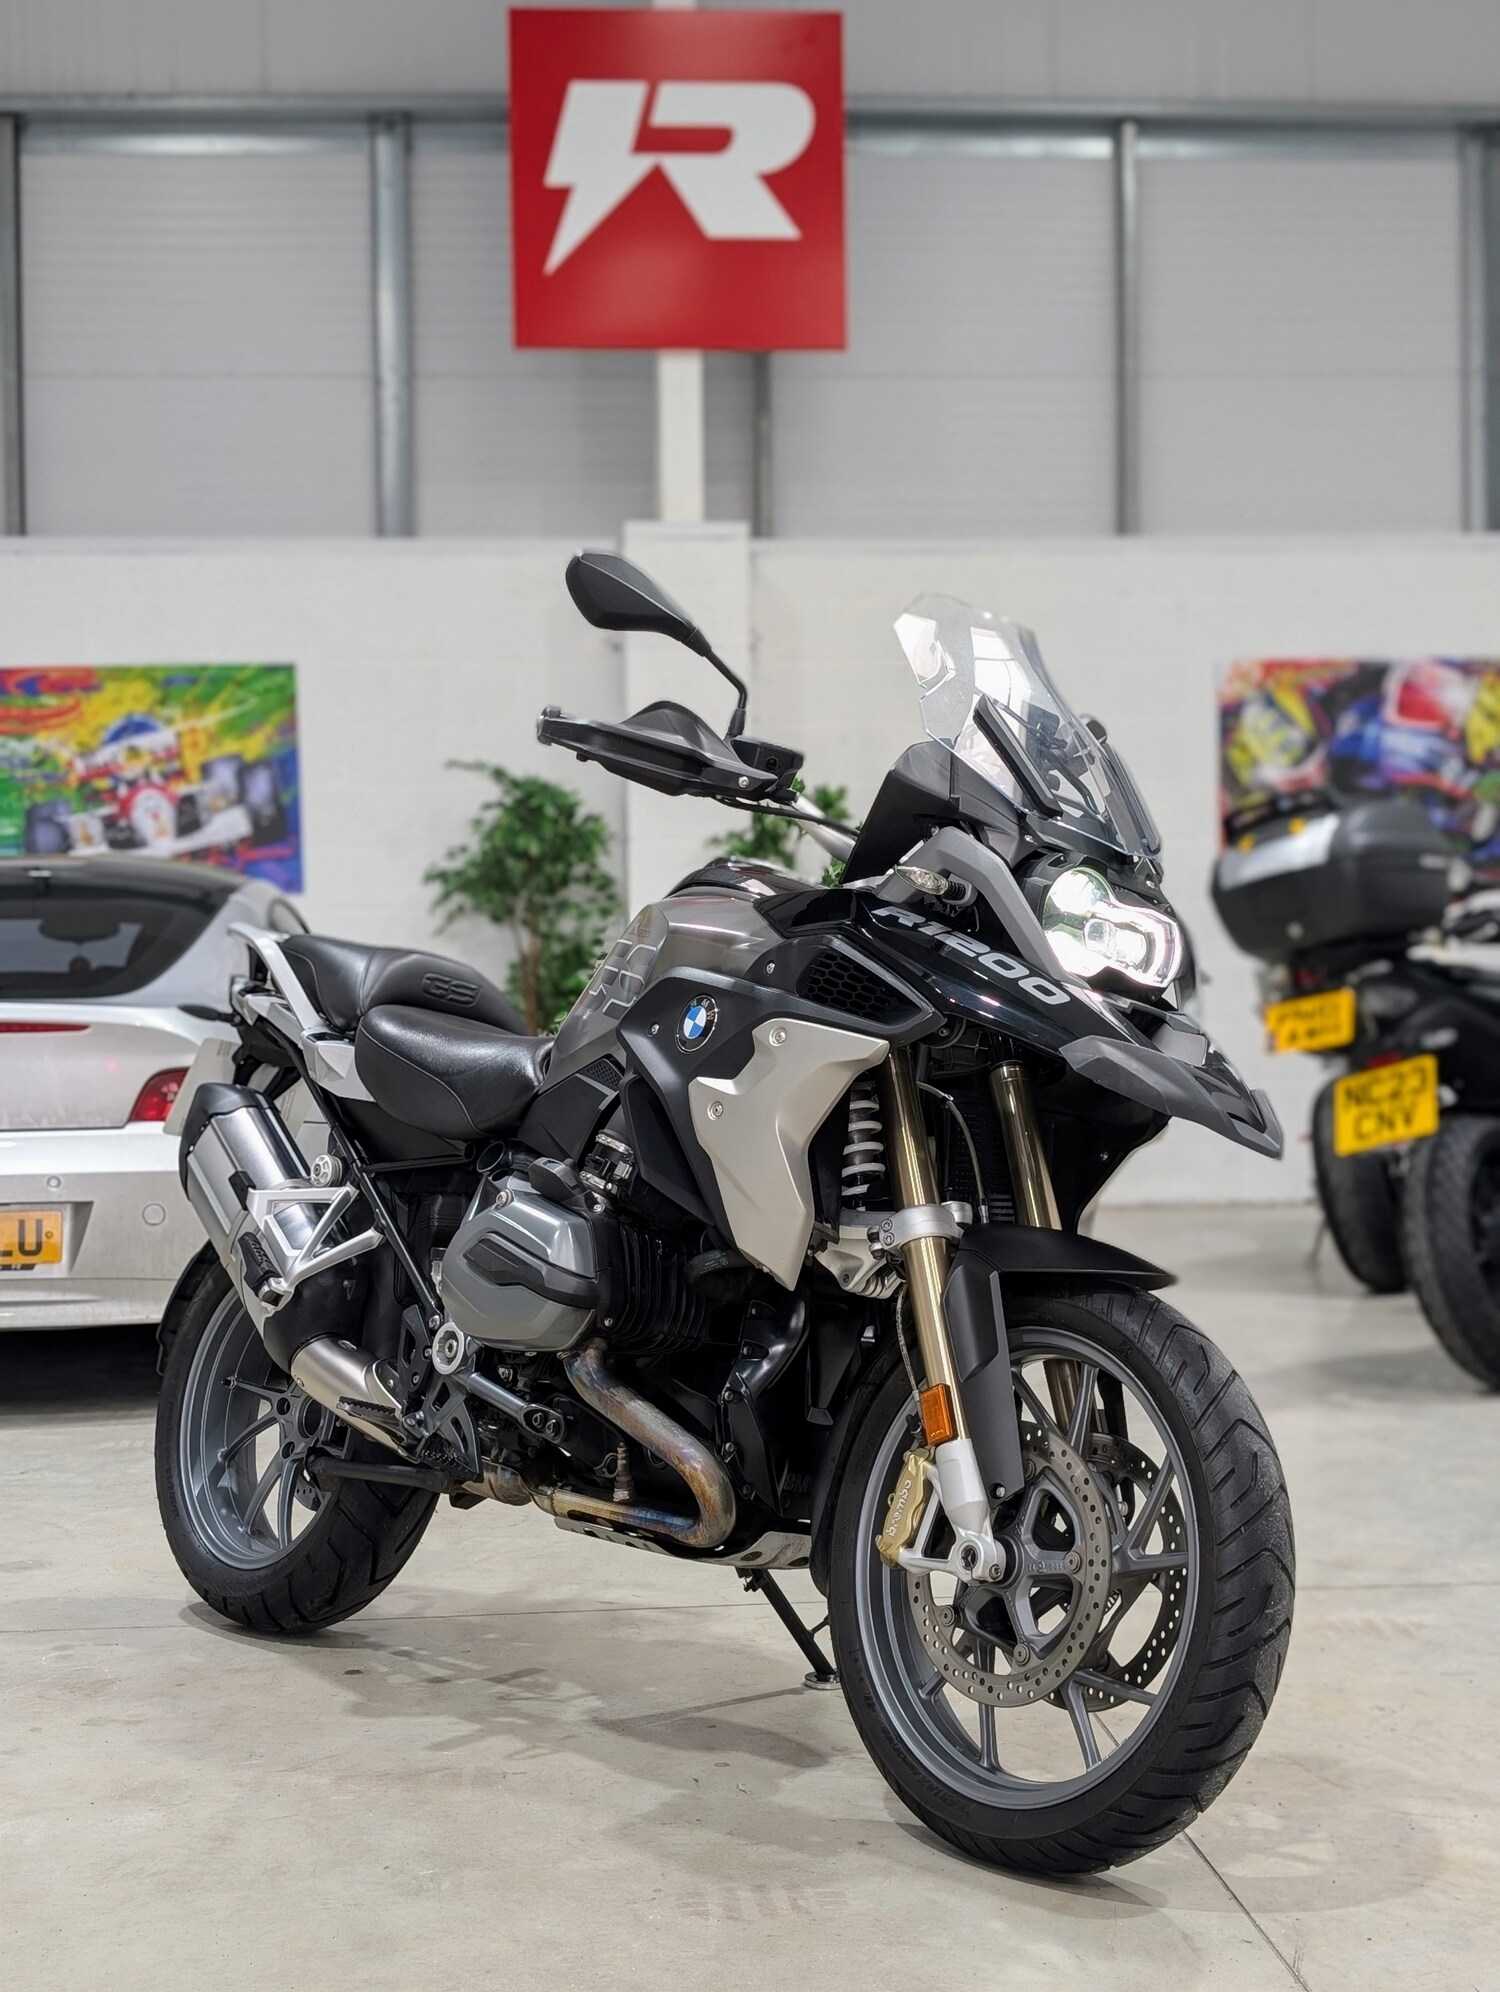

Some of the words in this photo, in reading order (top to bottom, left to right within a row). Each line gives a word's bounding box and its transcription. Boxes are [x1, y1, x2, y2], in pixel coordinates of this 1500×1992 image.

[871, 906, 1070, 1005] R1200
[422, 973, 480, 1008] GS
[690, 998, 716, 1021] BMW
[1353, 1102, 1416, 1141] CNV
[886, 1480, 912, 1537] brembo
